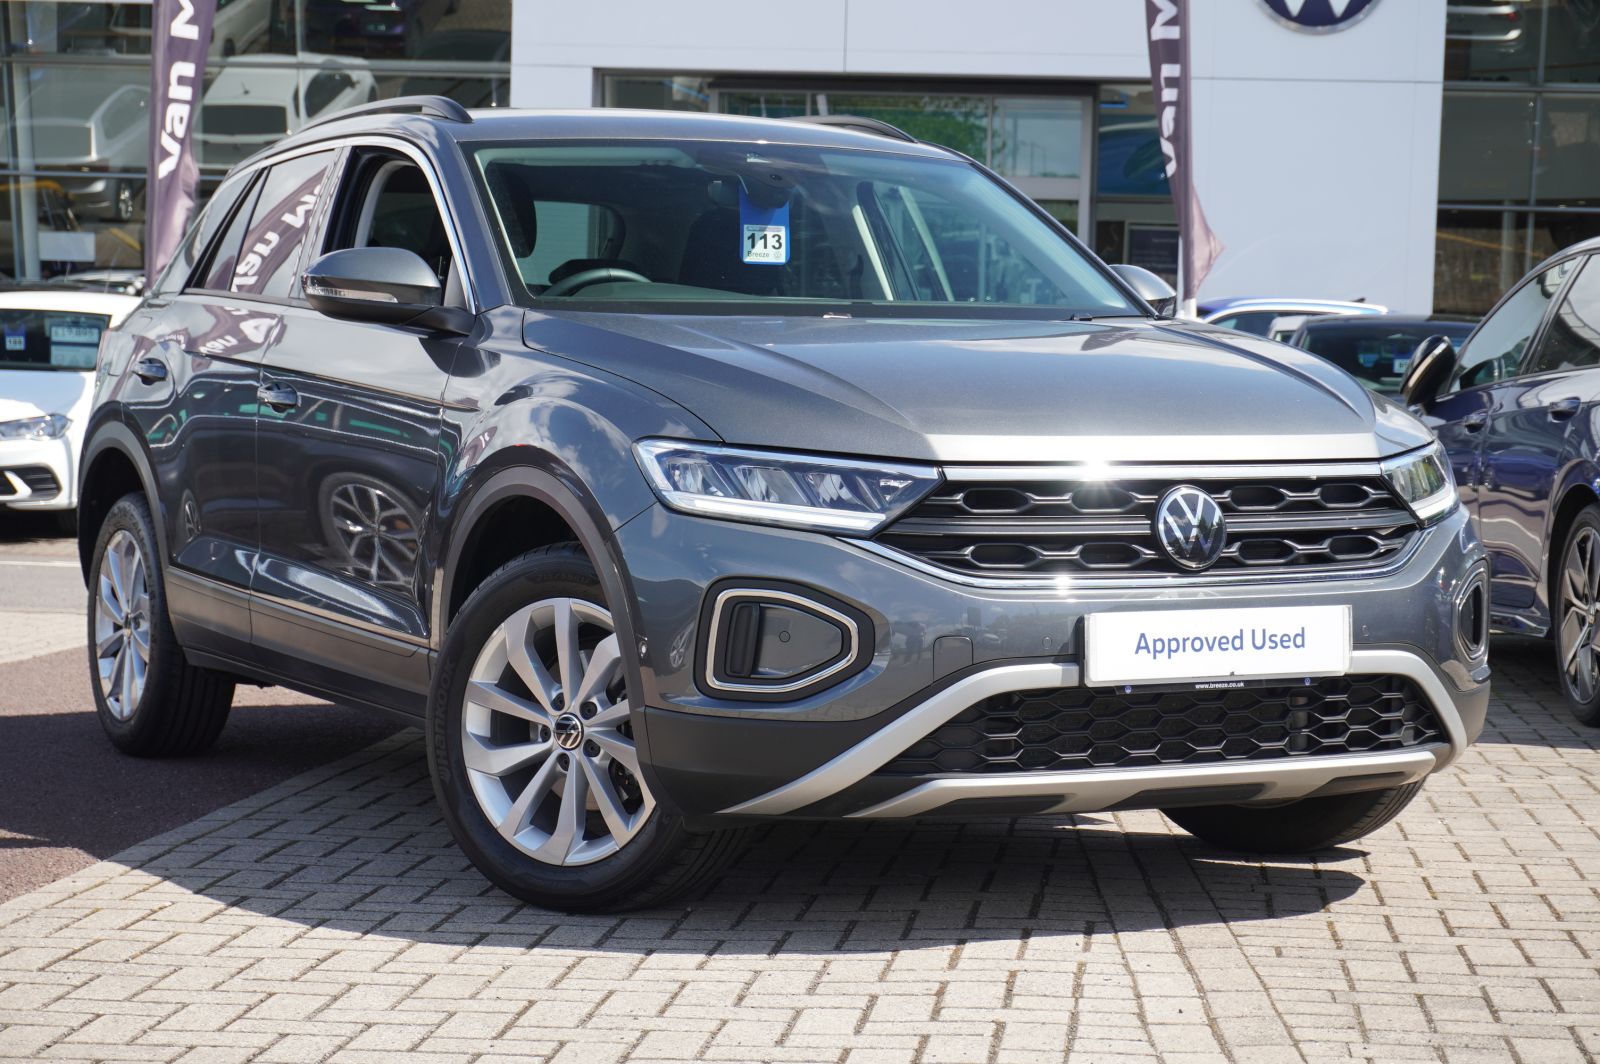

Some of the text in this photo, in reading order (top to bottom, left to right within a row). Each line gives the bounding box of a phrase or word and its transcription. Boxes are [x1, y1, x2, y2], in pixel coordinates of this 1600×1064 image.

[747, 232, 783, 250] 113
[1134, 626, 1306, 660] Approved Used
[1194, 681, 1245, 689] www.breeze.co.uk
